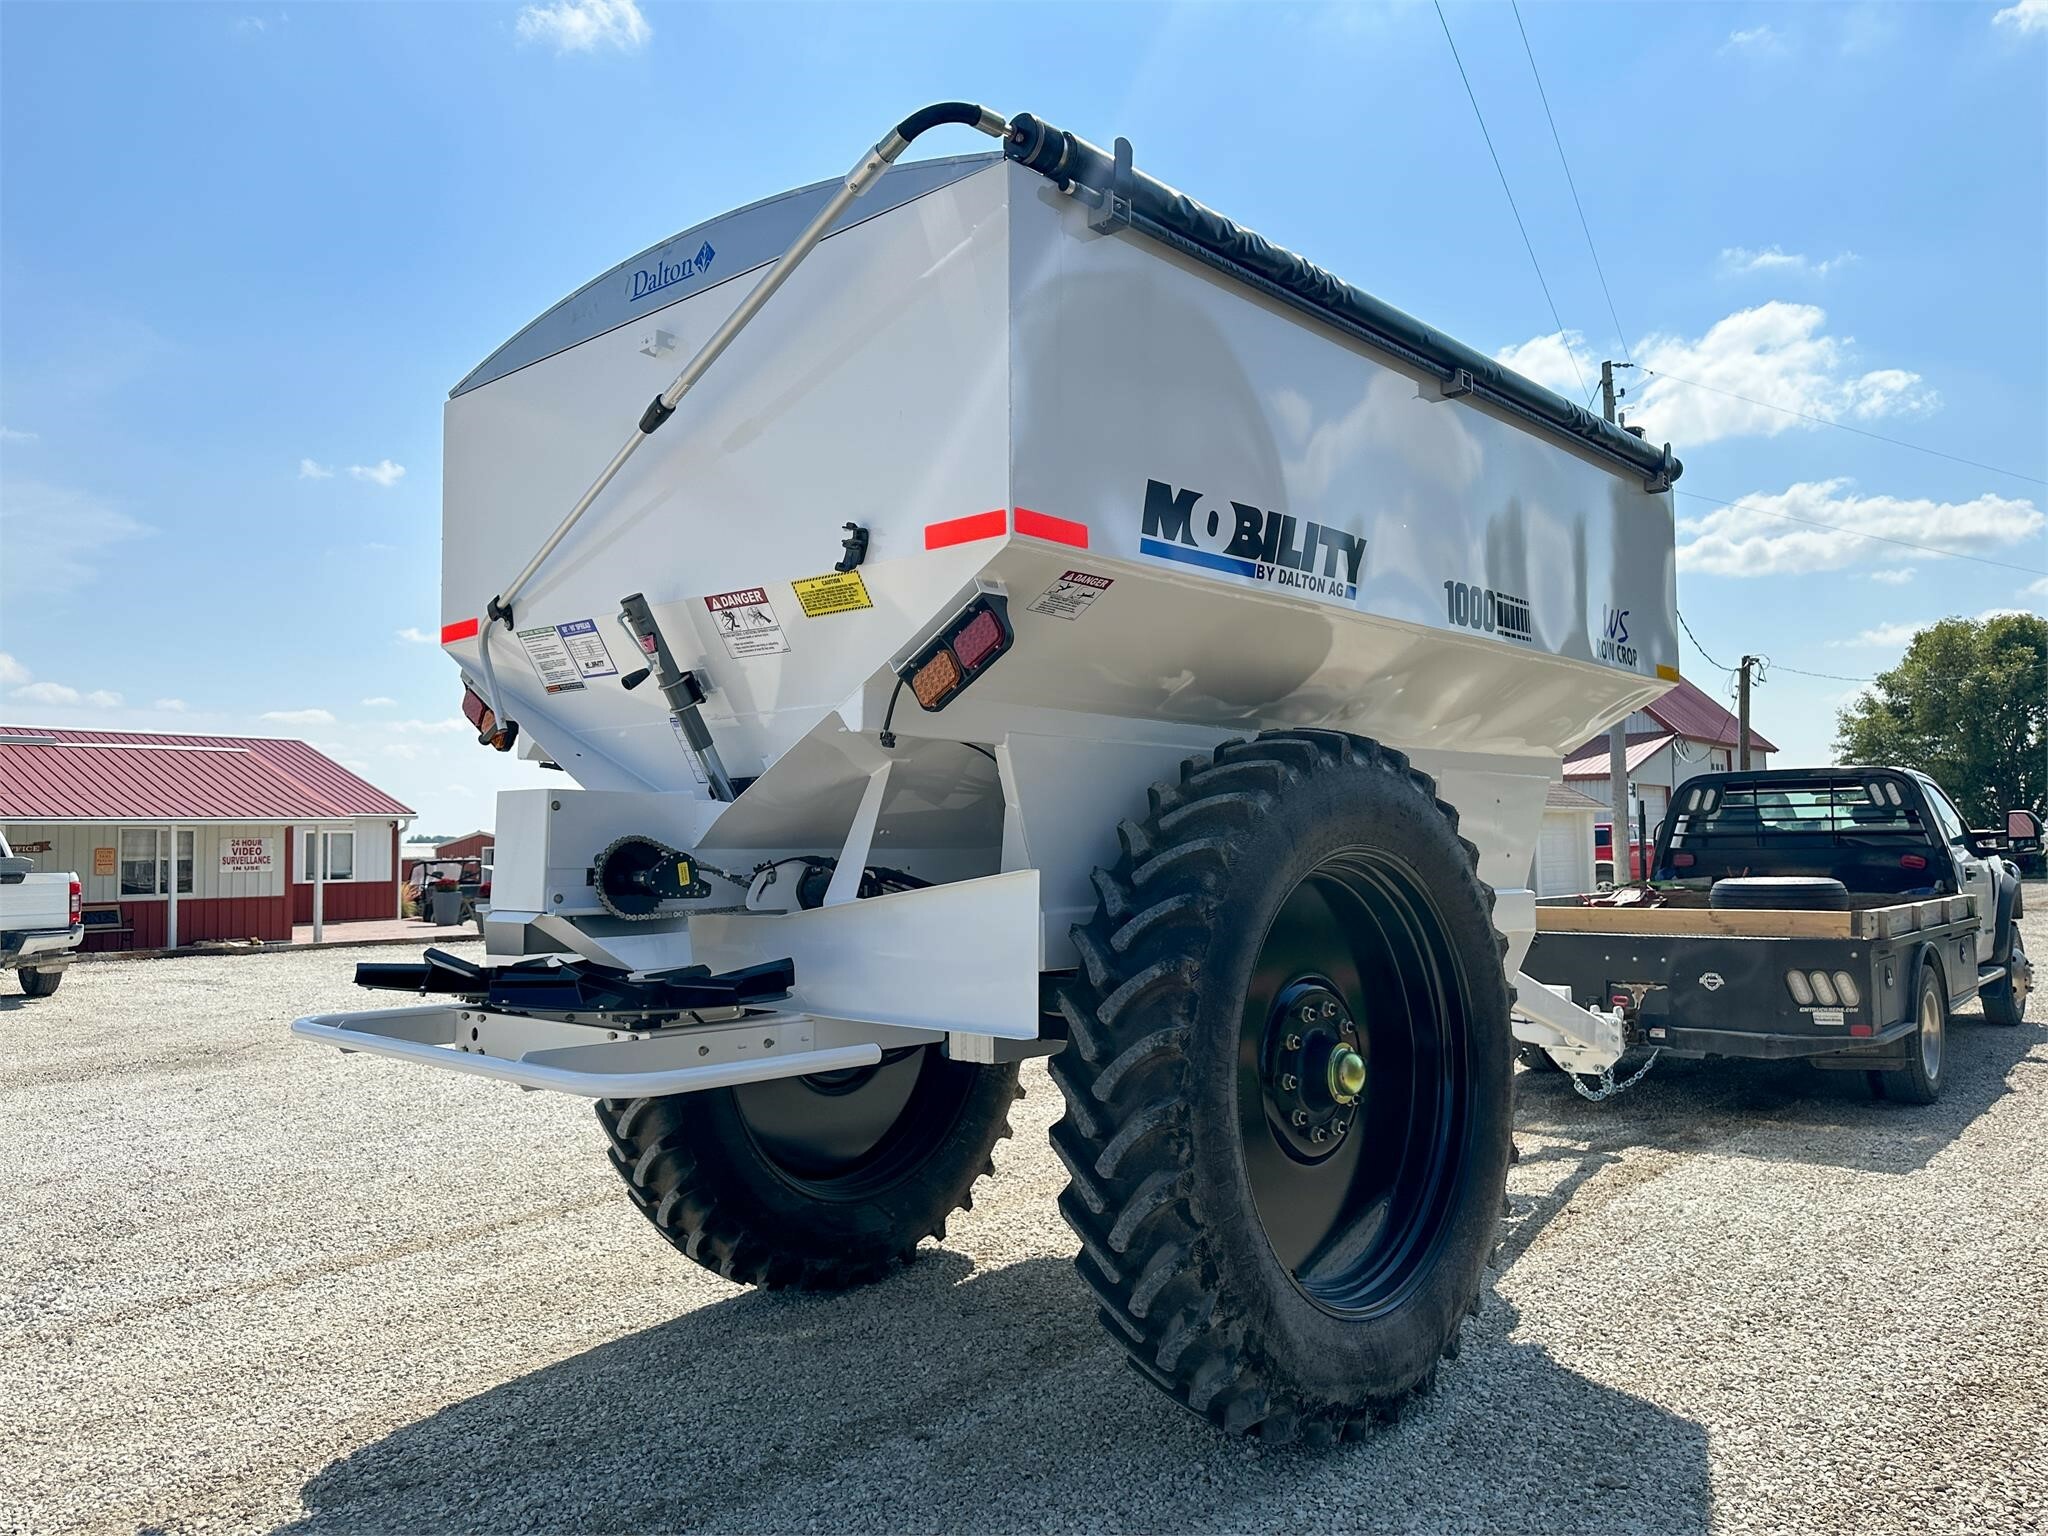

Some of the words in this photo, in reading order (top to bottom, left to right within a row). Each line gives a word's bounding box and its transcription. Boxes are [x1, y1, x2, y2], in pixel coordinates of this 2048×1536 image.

[632, 258, 694, 298] Dalton
[1141, 478, 1368, 584] MOBILITY
[1074, 574, 1109, 588] DANGER
[1256, 563, 1275, 582] BY
[1278, 569, 1325, 593] DALTON
[1328, 584, 1344, 597] AG
[720, 590, 763, 607] DANGER
[1444, 580, 1495, 633] 1000
[1603, 602, 1630, 643] WS
[1596, 638, 1615, 662] ROW
[1617, 644, 1637, 667] CROP
[231, 839, 240, 847] 24
[242, 839, 263, 847] HOUR
[231, 847, 262, 856] VIDEO
[222, 856, 272, 865] SURVEILLANCE
